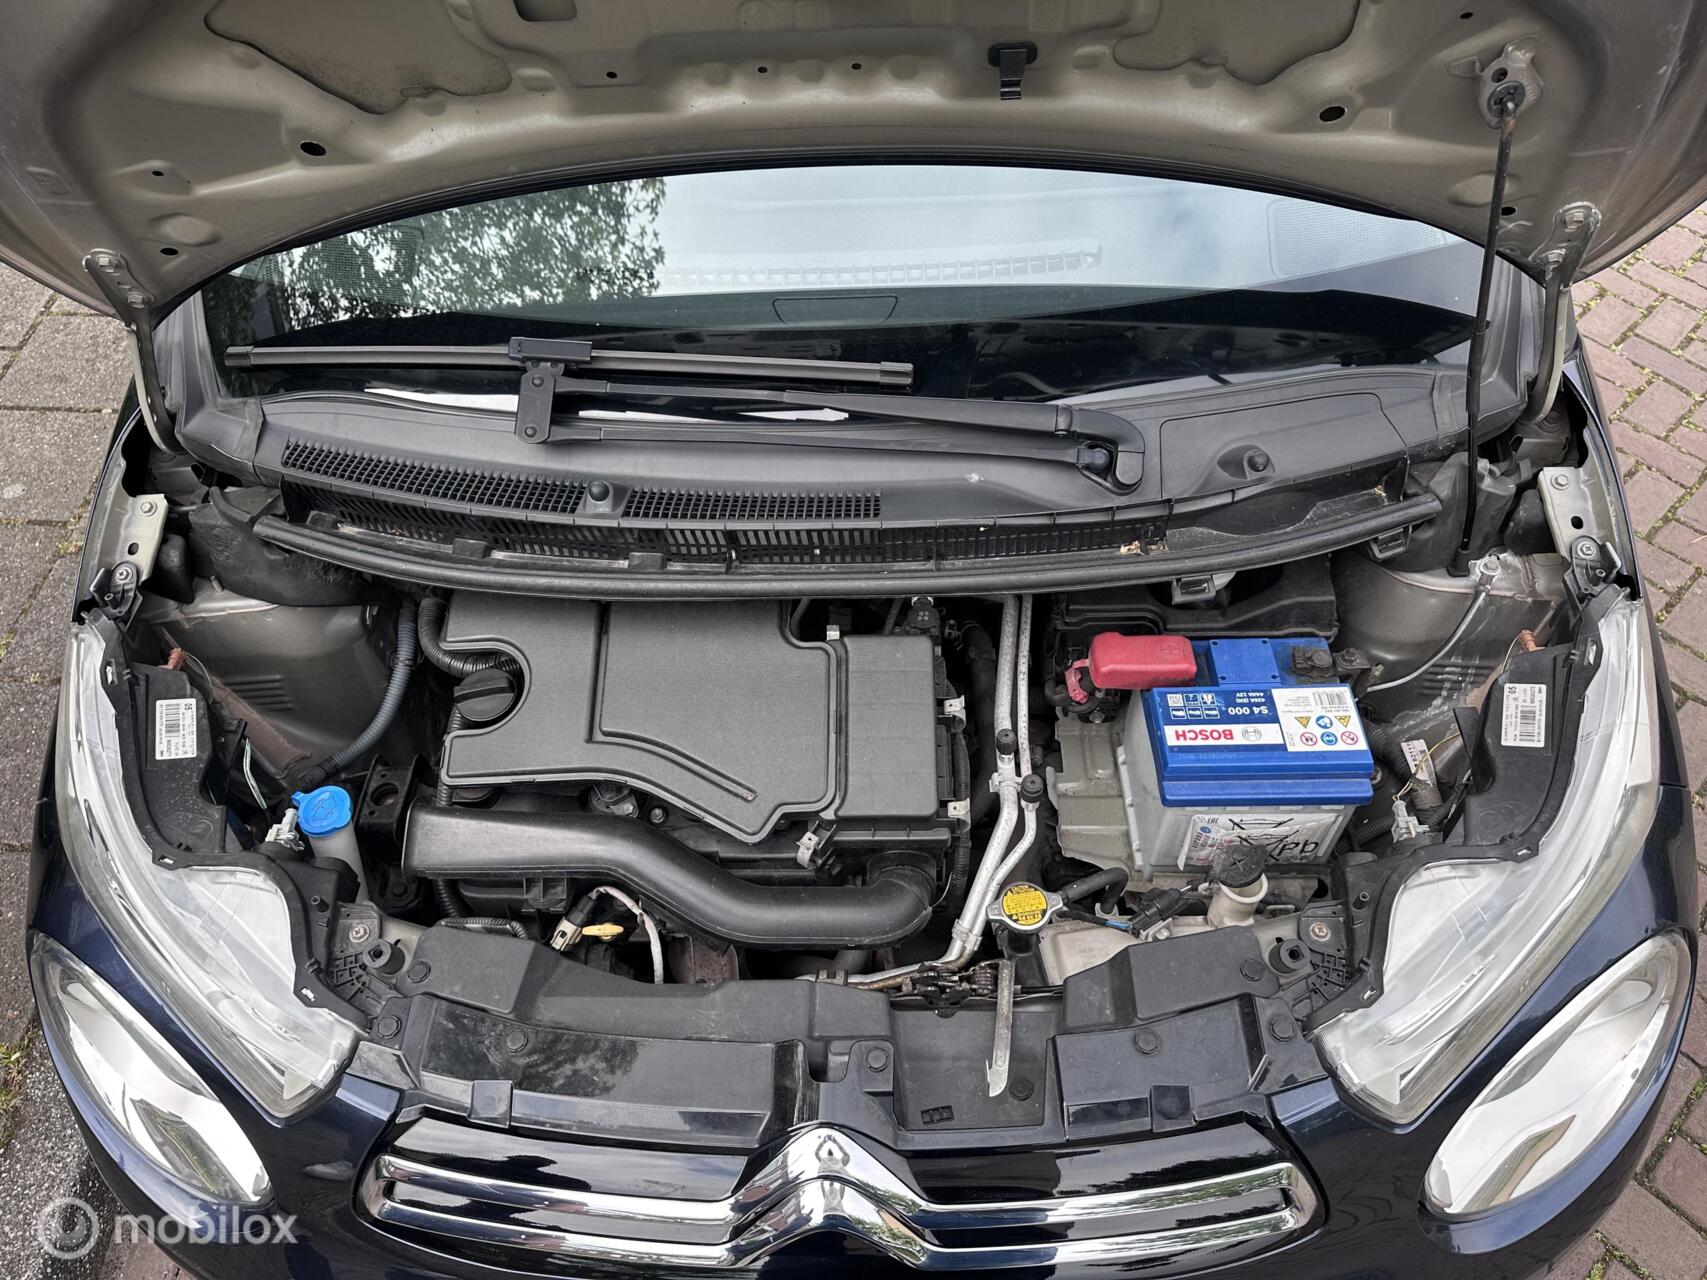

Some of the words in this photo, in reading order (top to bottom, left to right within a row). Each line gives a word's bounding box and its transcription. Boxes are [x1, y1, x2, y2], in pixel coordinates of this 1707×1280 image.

[1228, 707, 1250, 715] 000
[1253, 706, 1269, 714] S4
[1175, 729, 1234, 741] BOSCH
[1277, 840, 1319, 856] Pb
